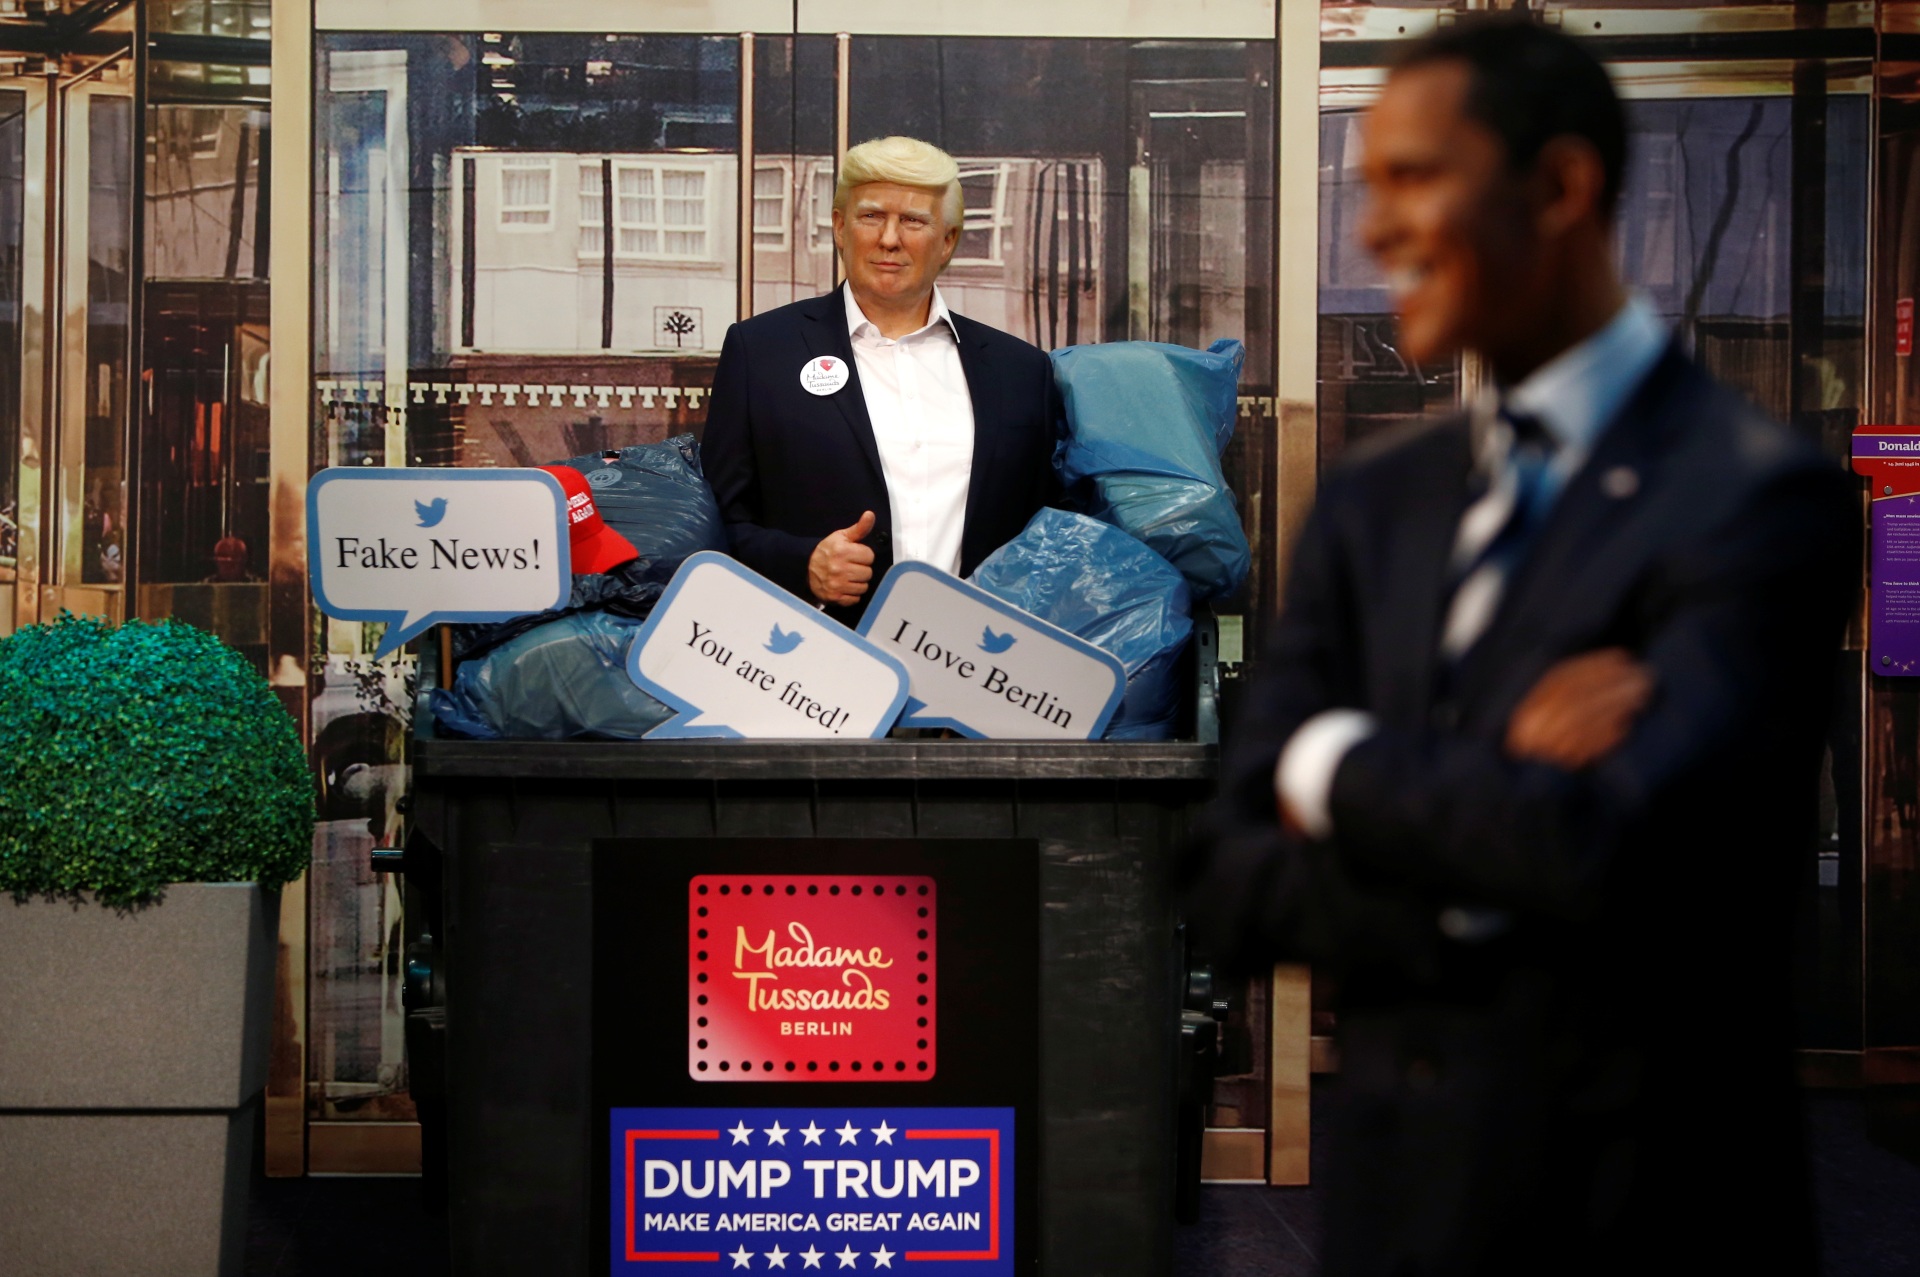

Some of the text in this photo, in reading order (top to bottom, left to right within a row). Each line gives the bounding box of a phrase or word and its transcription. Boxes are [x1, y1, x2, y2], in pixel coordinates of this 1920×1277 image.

[807, 372, 839, 382] Madame
[807, 379, 840, 389] Tussauds
[1878, 440, 1920, 451] Donald
[335, 537, 541, 570] Fake News!
[685, 620, 852, 735] You are fired!
[890, 618, 1073, 730] I love Berlin
[734, 921, 894, 970] Madame
[731, 968, 891, 1012] Tussauds
[780, 1021, 853, 1036] BERLIN
[644, 1159, 981, 1199] DUMP TRUMP
[644, 1212, 981, 1232] MAKE AMERICA GREAT AGAIN
